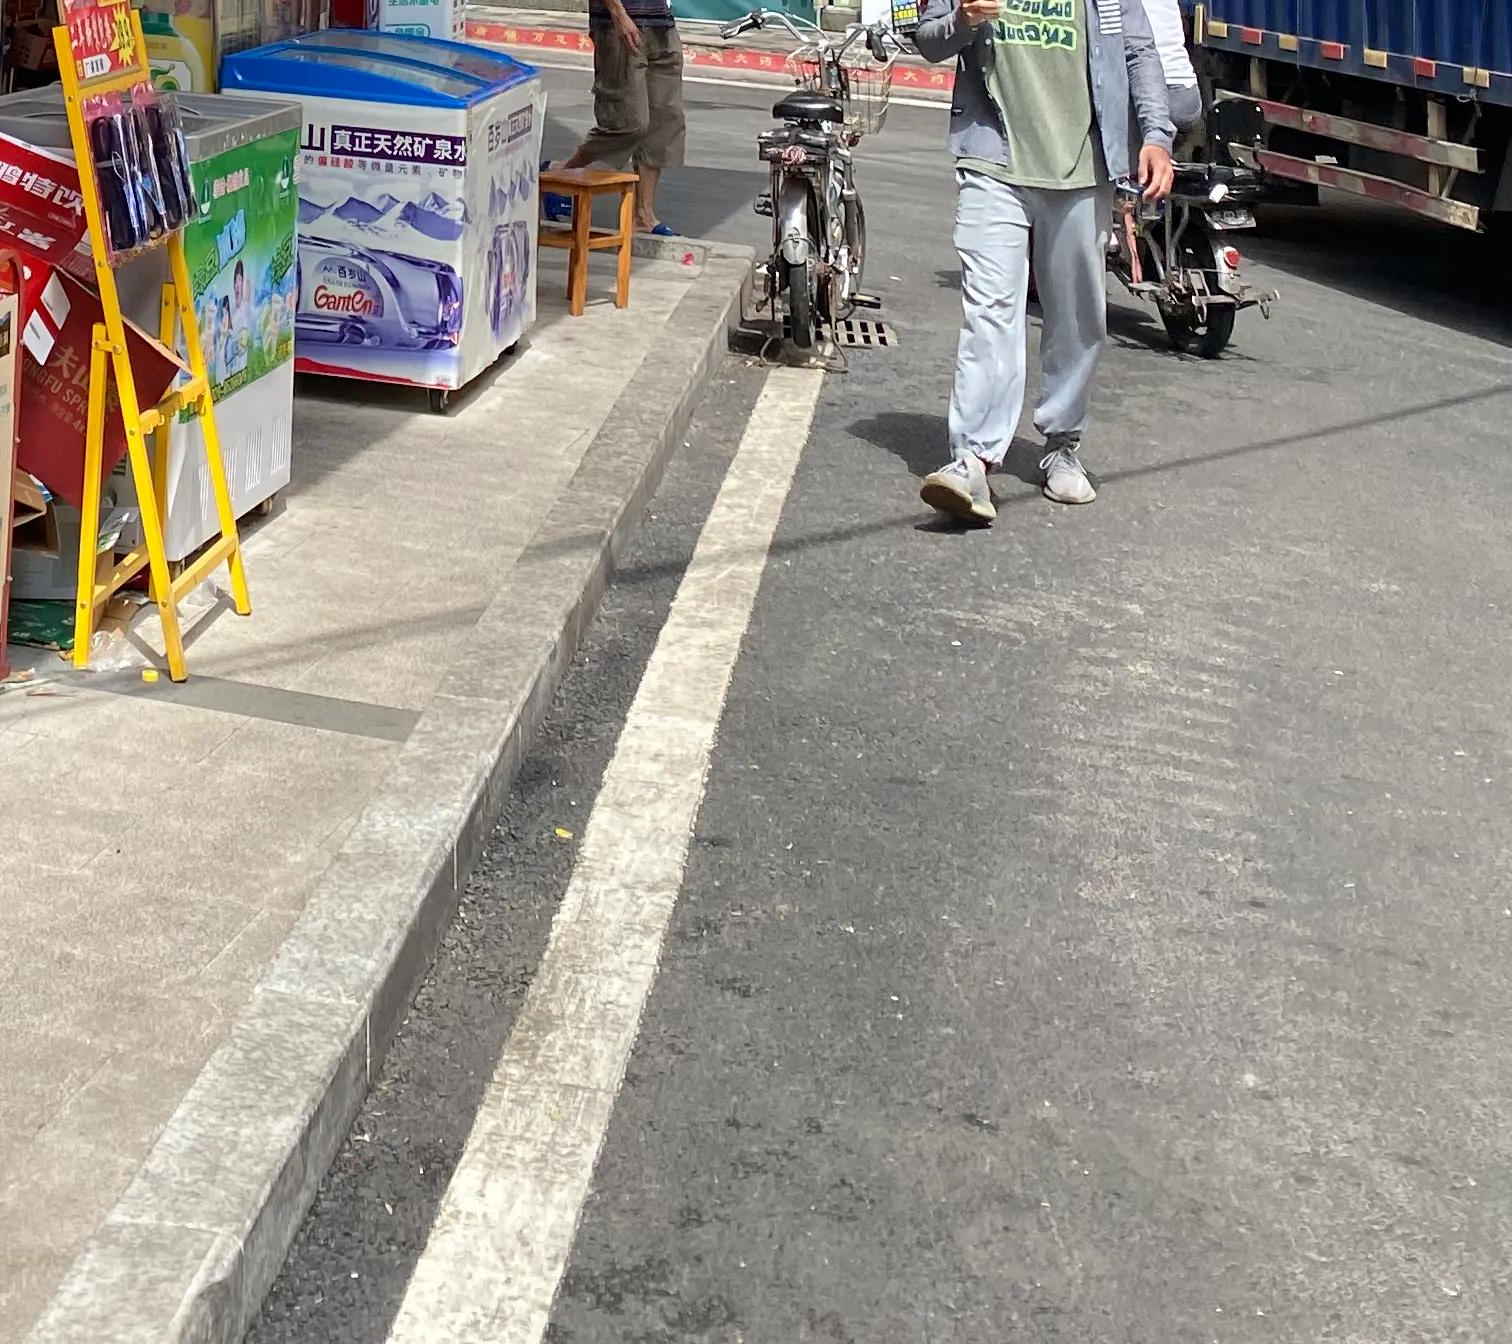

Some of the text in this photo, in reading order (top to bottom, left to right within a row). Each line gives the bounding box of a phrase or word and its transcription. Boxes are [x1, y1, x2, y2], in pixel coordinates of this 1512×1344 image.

[332, 128, 467, 162] 真正天然矿泉水
